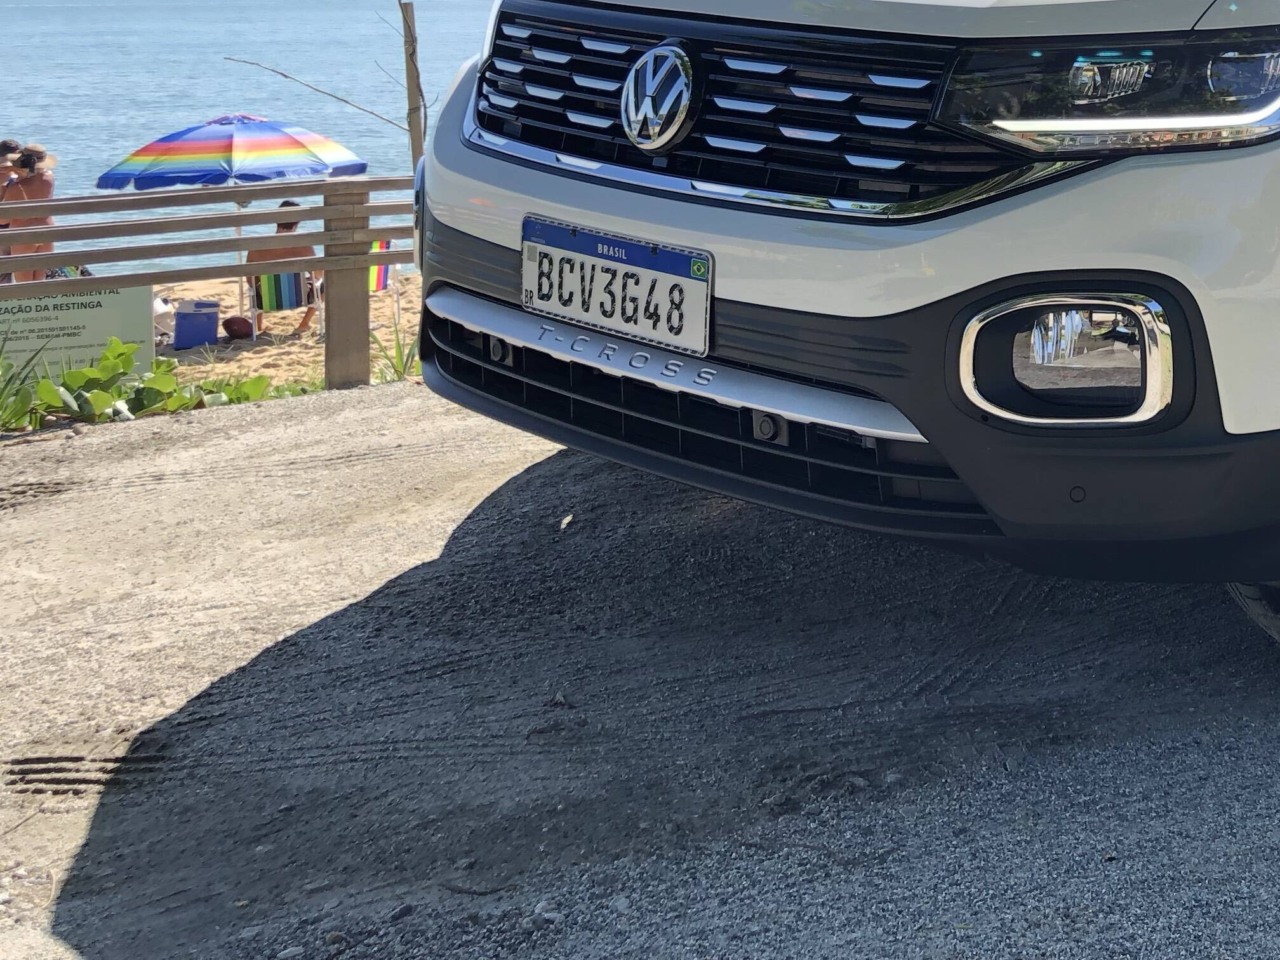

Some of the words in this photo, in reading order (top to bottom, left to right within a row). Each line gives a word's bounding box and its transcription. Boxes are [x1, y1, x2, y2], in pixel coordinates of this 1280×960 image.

[597, 243, 628, 260] BRASIL
[524, 288, 534, 306] BR
[537, 251, 685, 336] BCV3G48
[35, 304, 50, 313] DA
[53, 300, 102, 311] RESTINGA
[537, 325, 717, 386] T-CROSS
